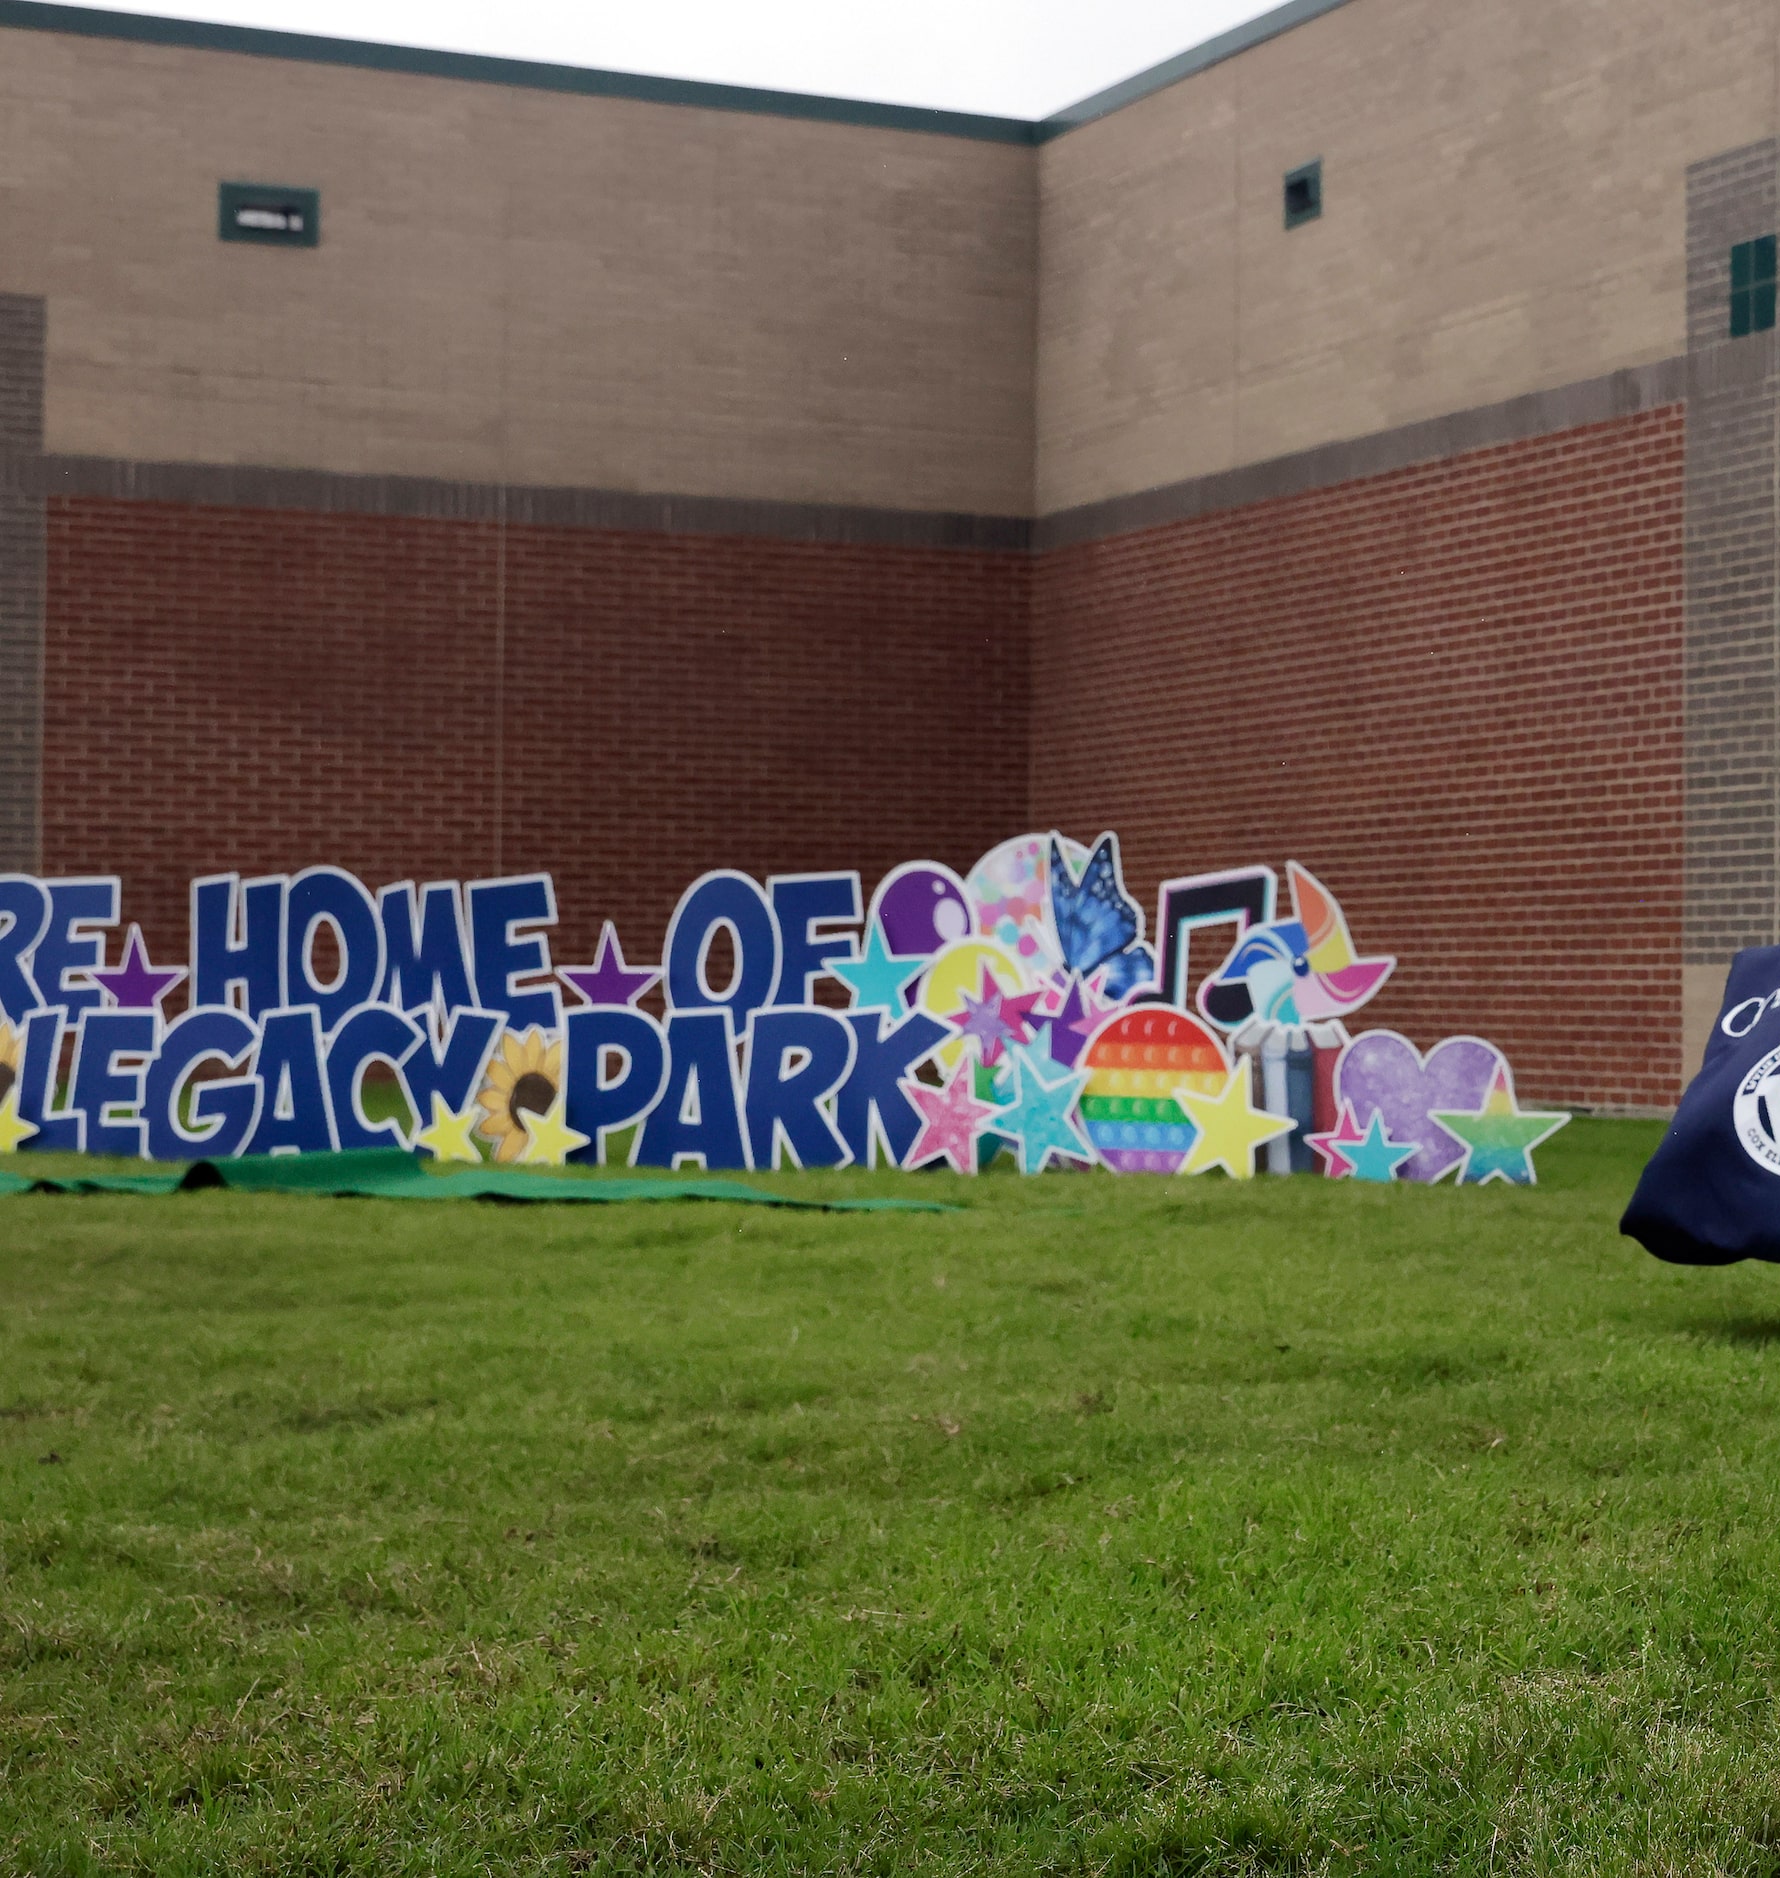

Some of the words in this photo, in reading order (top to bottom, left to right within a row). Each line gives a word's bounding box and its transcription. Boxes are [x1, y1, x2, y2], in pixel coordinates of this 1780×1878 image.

[190, 866, 563, 1029] HOME
[664, 868, 864, 1032] OF
[15, 1003, 506, 1160] LEGACY
[562, 1003, 957, 1171] PARK
[1746, 1127, 1766, 1151] COX
